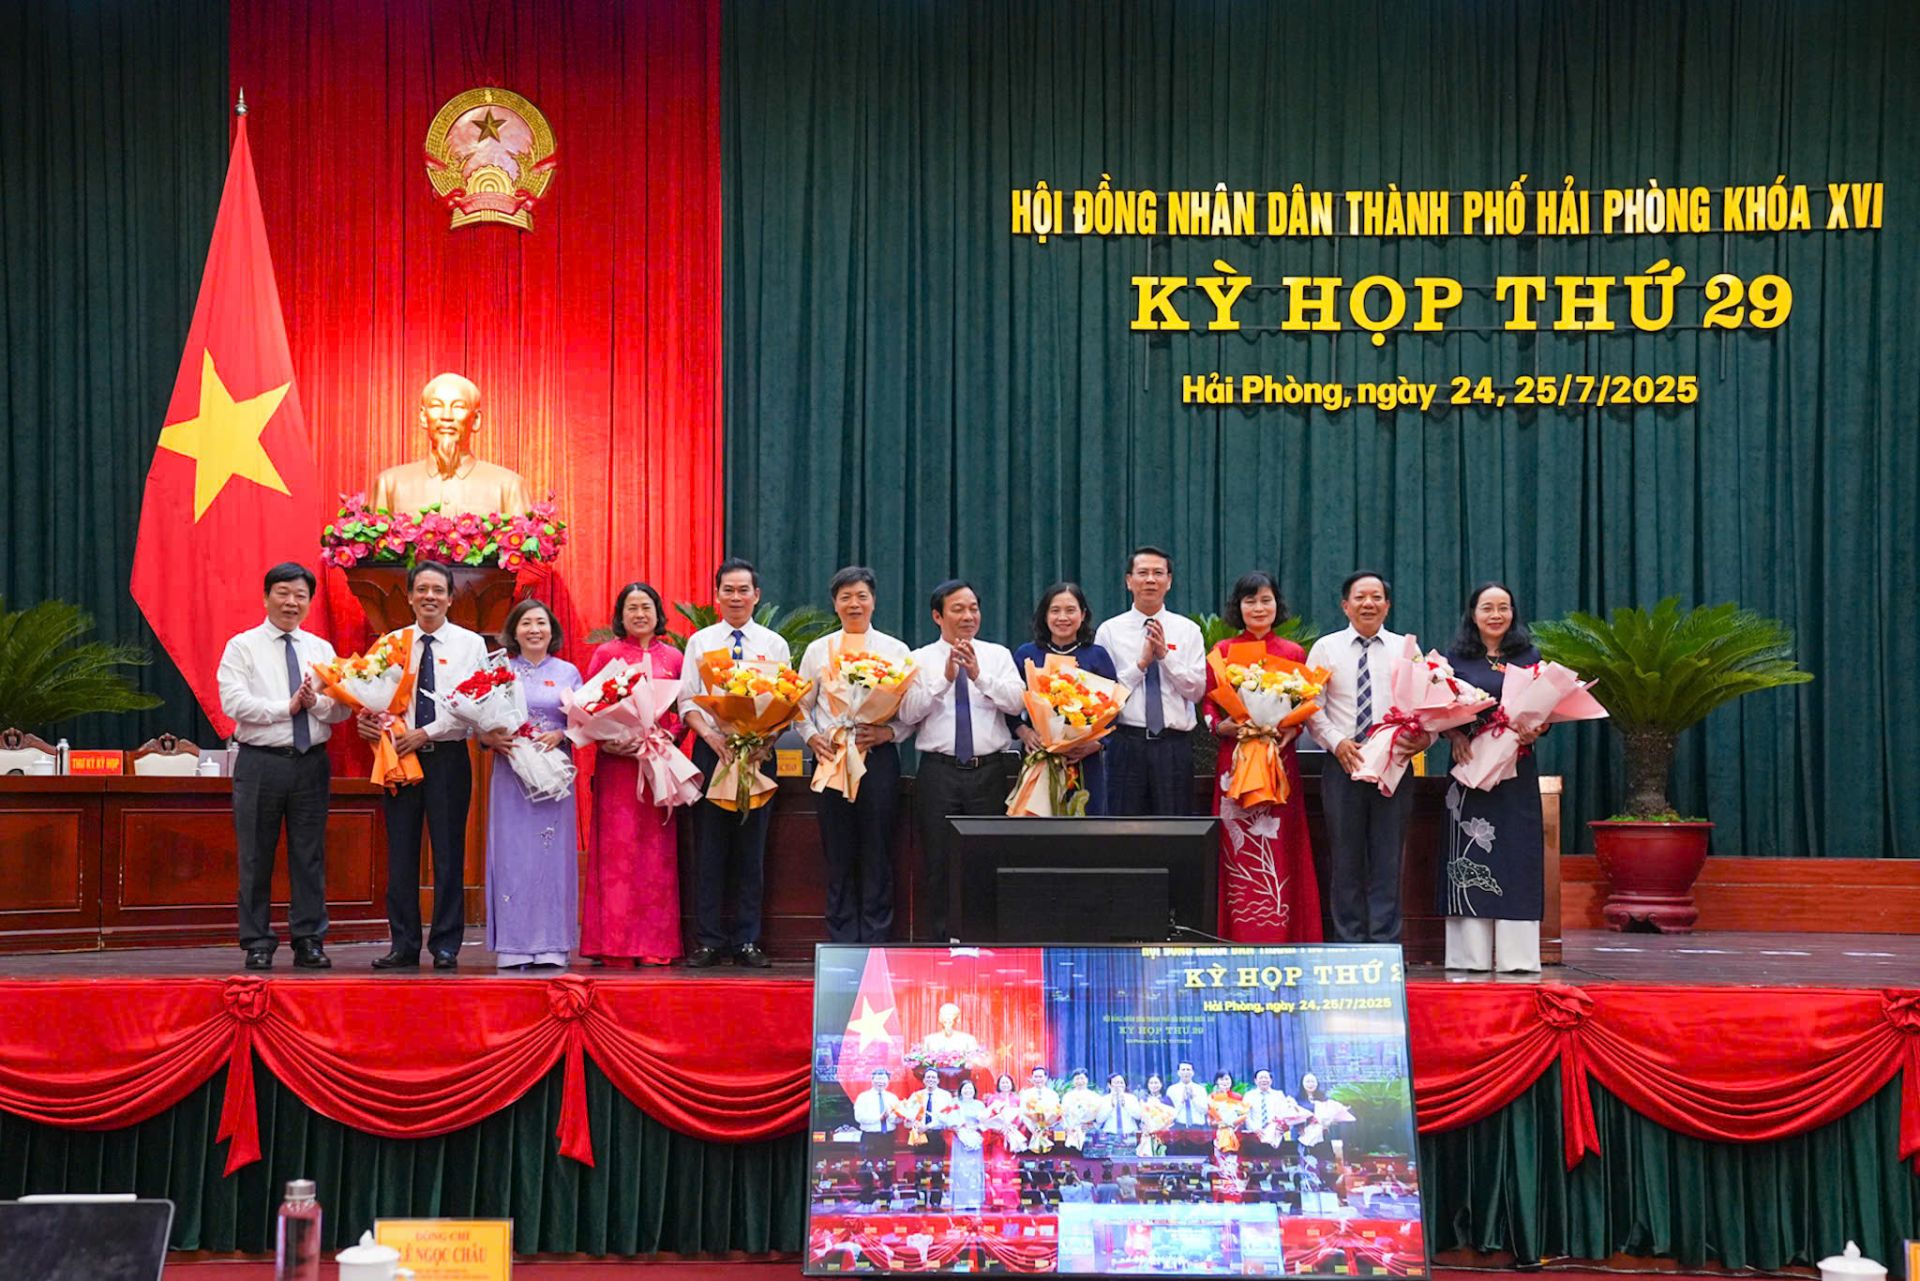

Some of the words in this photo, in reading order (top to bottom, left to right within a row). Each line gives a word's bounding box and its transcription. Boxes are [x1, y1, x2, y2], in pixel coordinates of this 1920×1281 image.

[1011, 180, 1063, 244] HỘI
[1073, 173, 1157, 236] ĐỒNG
[1168, 182, 1256, 236] NHÂN
[1267, 183, 1333, 236] DÂN
[1345, 183, 1450, 236] THÀNH
[1463, 174, 1527, 236] PHỐ
[1536, 176, 1590, 236] HẢI
[1603, 179, 1711, 235] PHÒNG
[1723, 174, 1811, 233] KHÓA
[1825, 182, 1884, 231] XVI
[1130, 258, 1252, 331] KỲ
[1281, 274, 1464, 347] HỌP
[1495, 258, 1687, 332] THỨ
[1702, 273, 1793, 330] 29
[1182, 371, 1234, 404] Hải
[1241, 374, 1352, 411] Phòng,
[1357, 375, 1438, 411] ngày
[1450, 376, 1506, 408] 24,
[1513, 373, 1699, 407] 25/7/2025
[1184, 962, 1228, 988] KỲ
[1236, 966, 1303, 992] HỌP
[1313, 958, 1385, 986] THỨ
[1265, 999, 1295, 1014] ngày
[1299, 999, 1321, 1011] 24,
[415, 1246, 451, 1267] NGỌC
